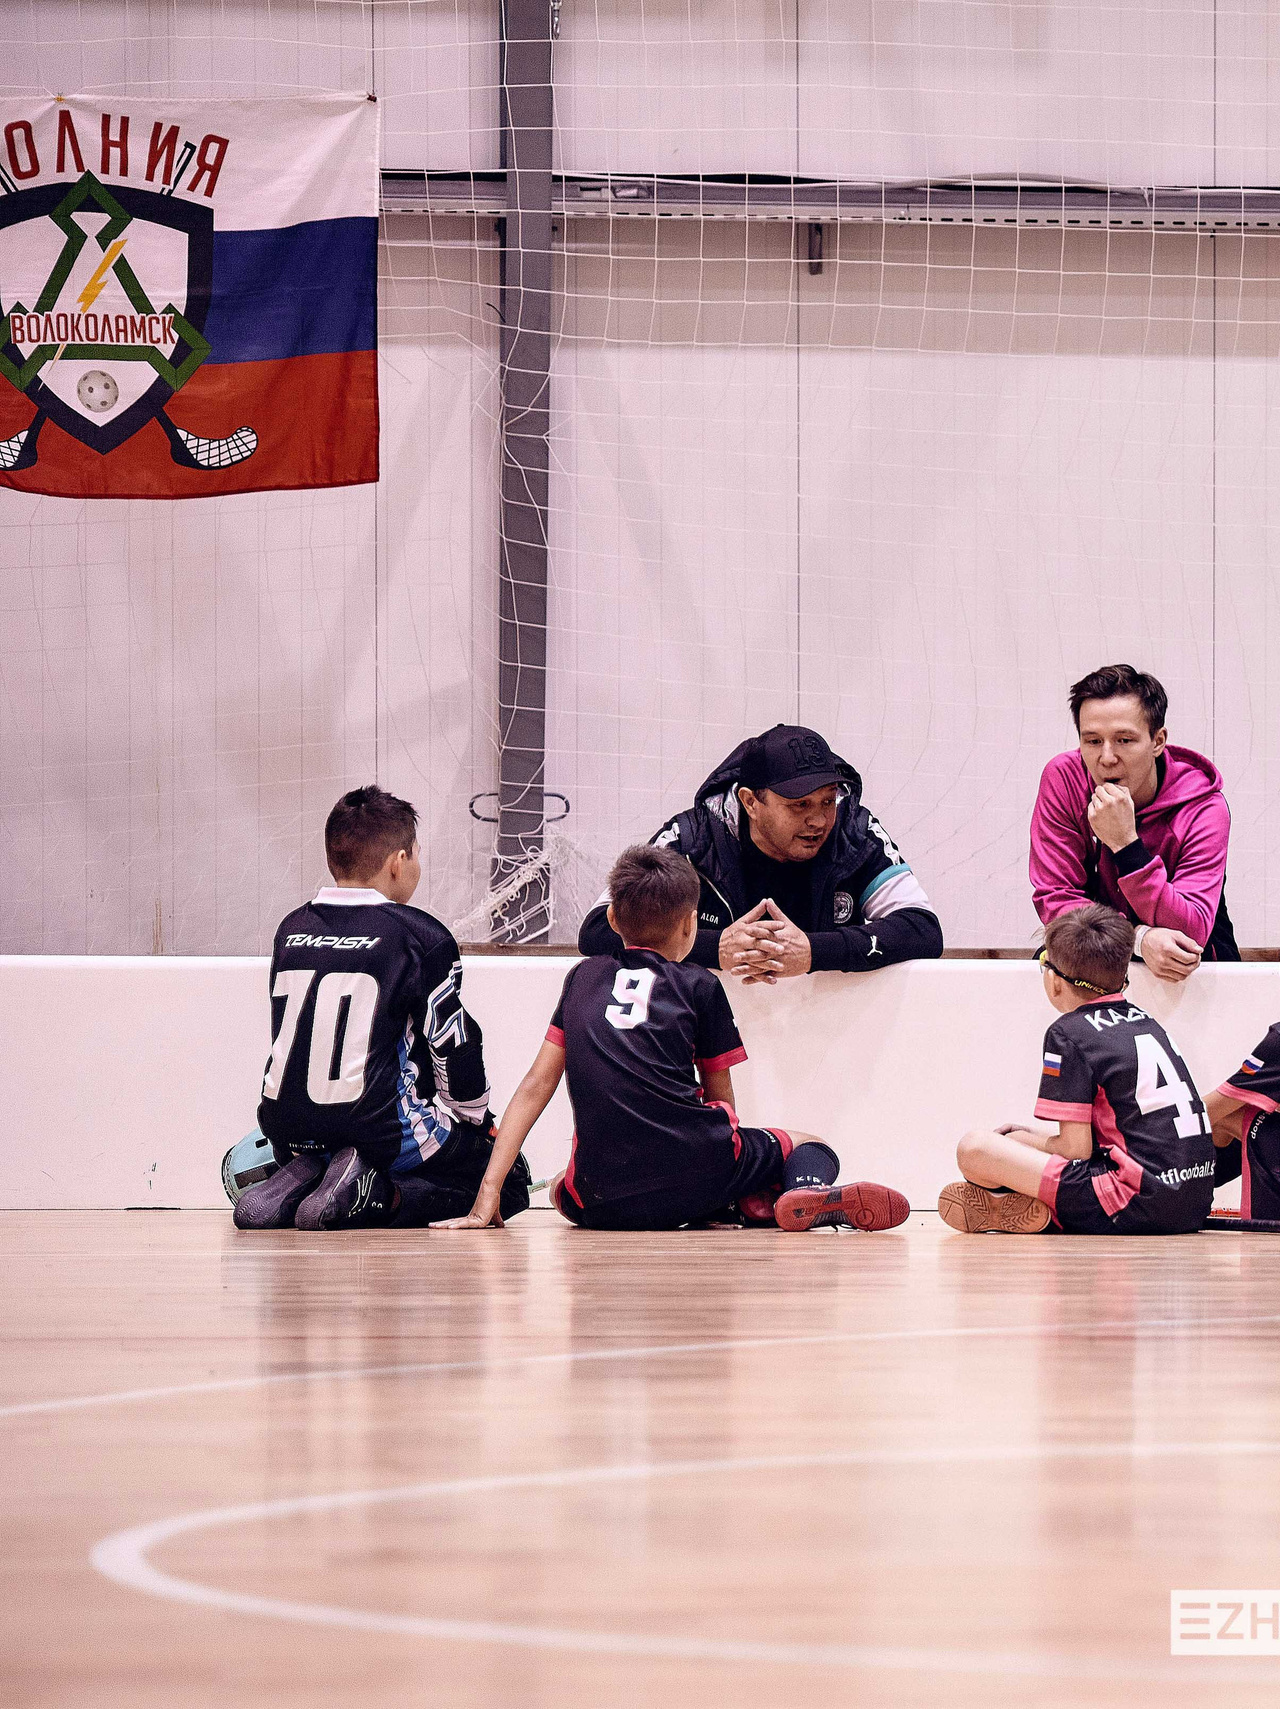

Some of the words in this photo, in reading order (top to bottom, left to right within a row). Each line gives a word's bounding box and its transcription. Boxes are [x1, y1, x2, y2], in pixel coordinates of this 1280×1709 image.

[11, 313, 176, 345] ВОЛОКОЛАМСК
[701, 912, 719, 925] ALGA
[285, 933, 381, 949] TEMPISH
[605, 968, 655, 1030] 9
[263, 969, 380, 1105] 70
